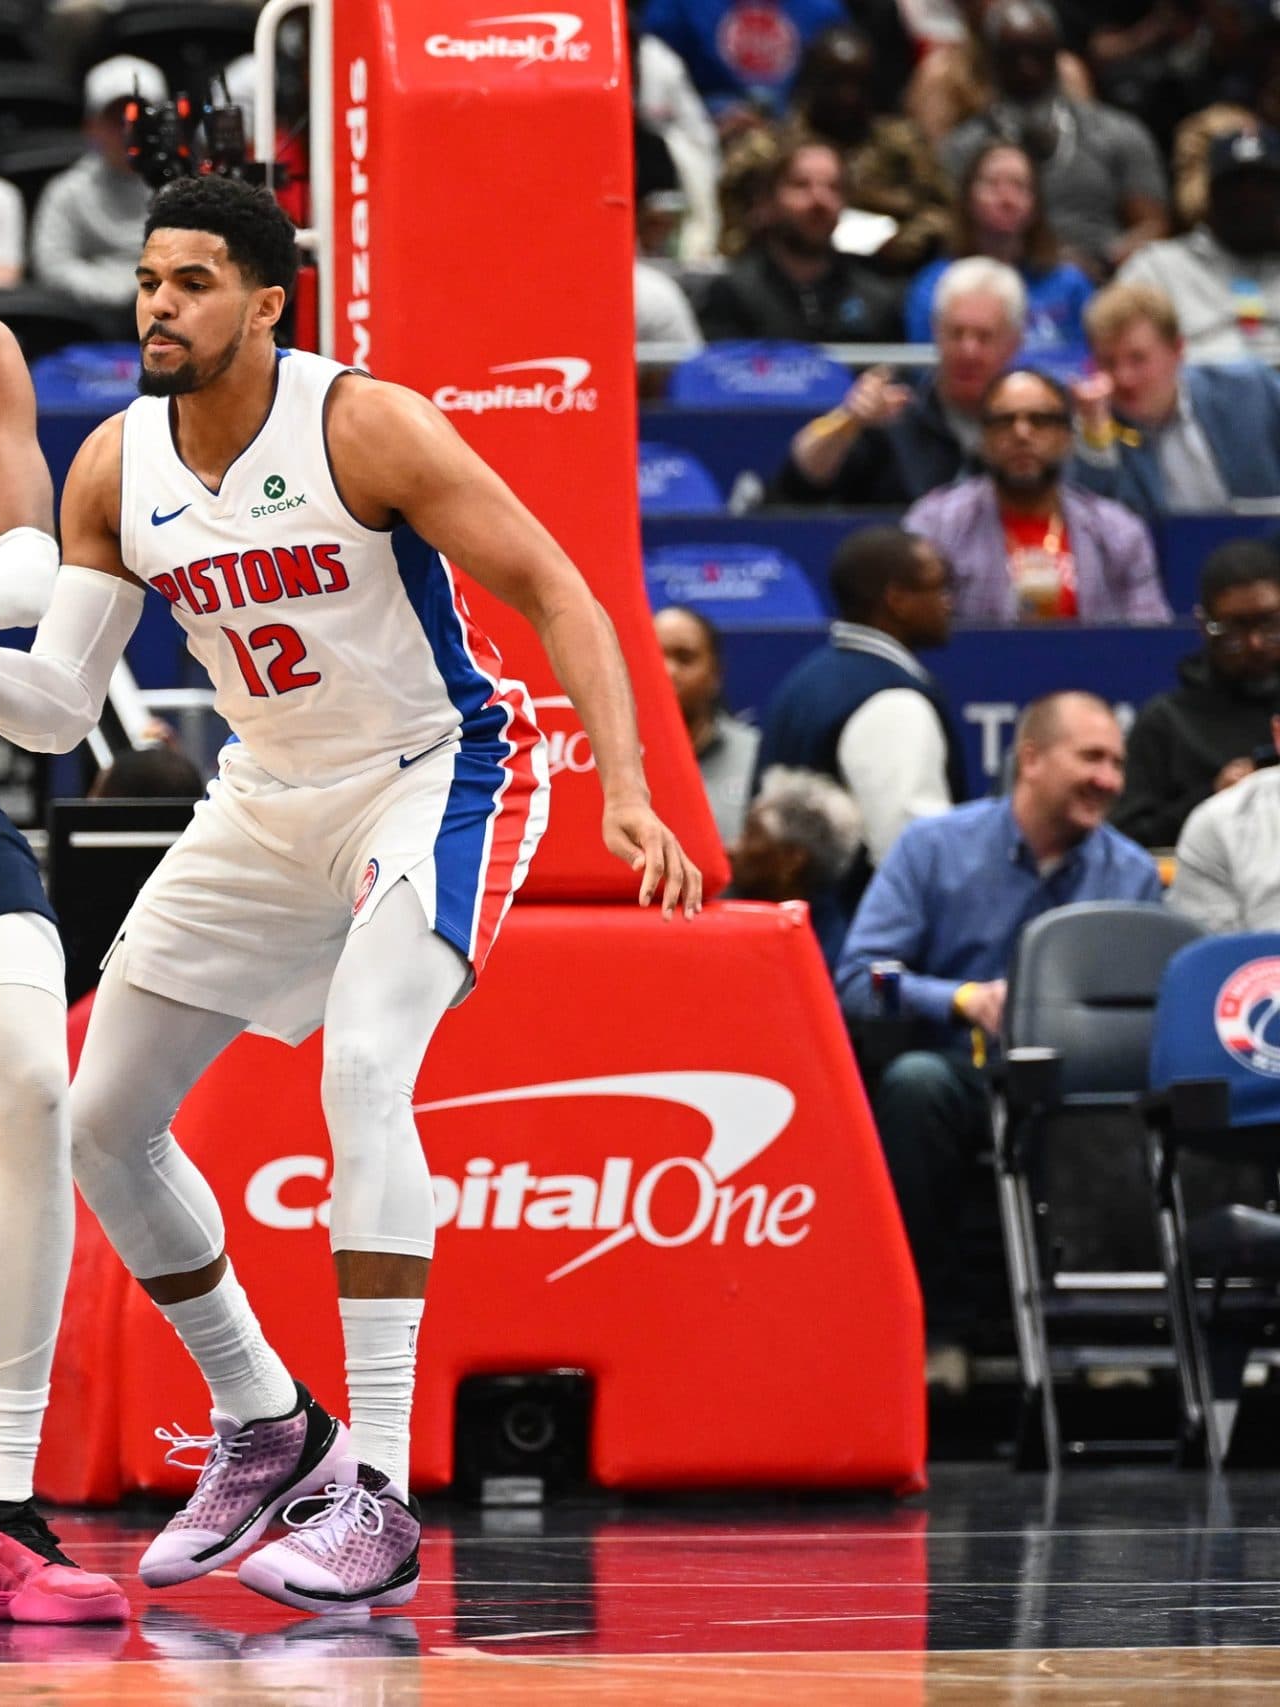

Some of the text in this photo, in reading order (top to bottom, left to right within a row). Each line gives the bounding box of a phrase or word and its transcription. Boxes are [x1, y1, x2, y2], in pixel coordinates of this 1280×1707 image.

[251, 494, 307, 518] StockX
[147, 543, 350, 615] PISTONS
[220, 623, 322, 697] 12
